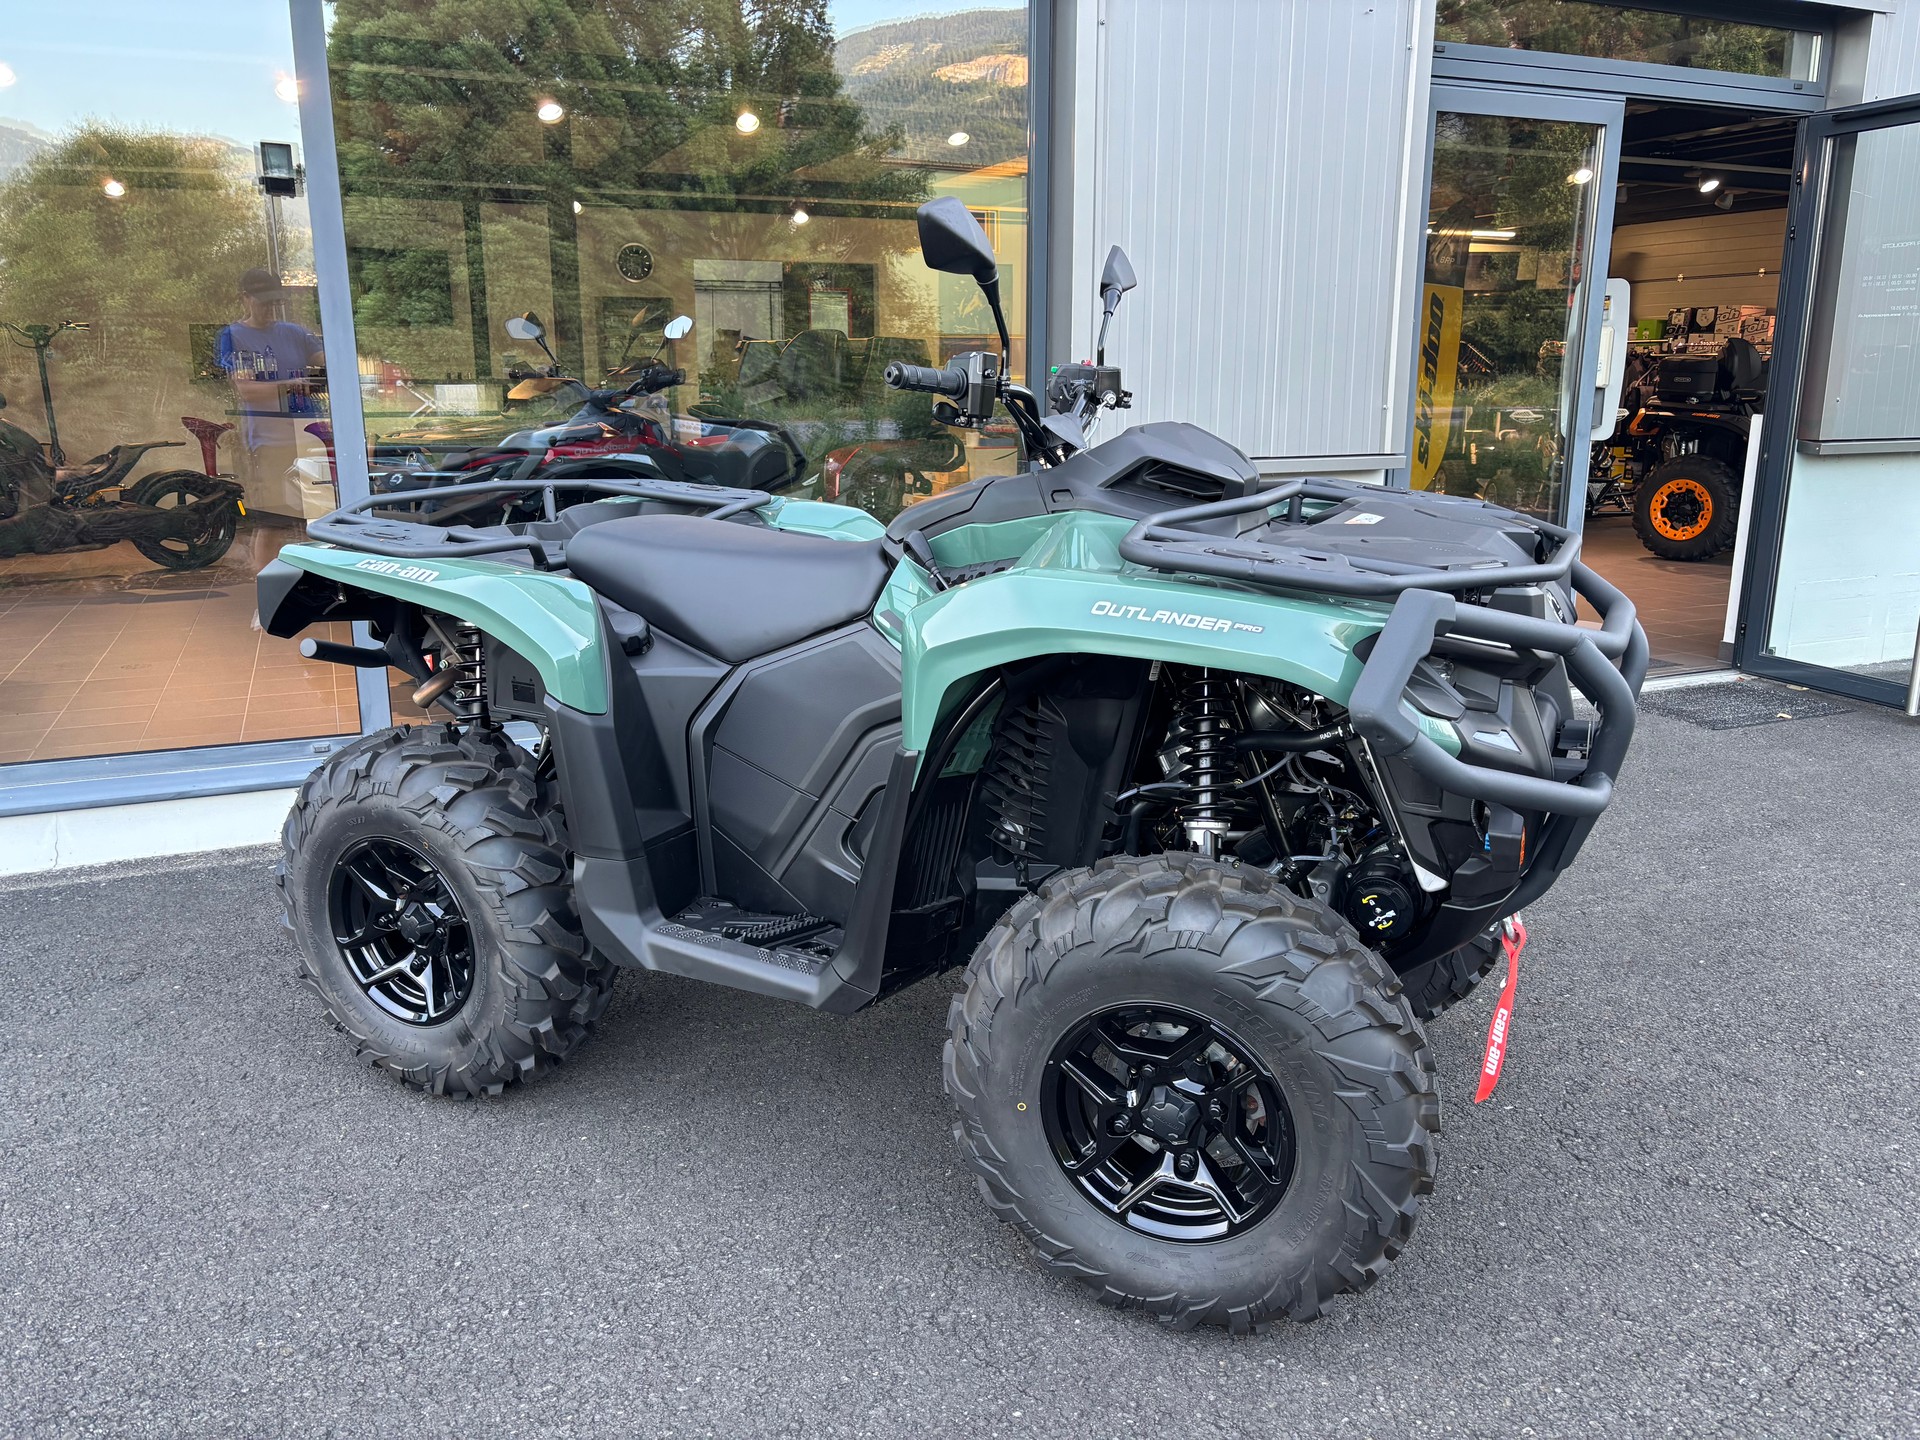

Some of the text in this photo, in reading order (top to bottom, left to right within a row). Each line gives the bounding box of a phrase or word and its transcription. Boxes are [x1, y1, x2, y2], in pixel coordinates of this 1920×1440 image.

[355, 558, 440, 583] can-am
[1090, 600, 1264, 634] OUTLANDER PRO
[1484, 1007, 1509, 1076] can-am
